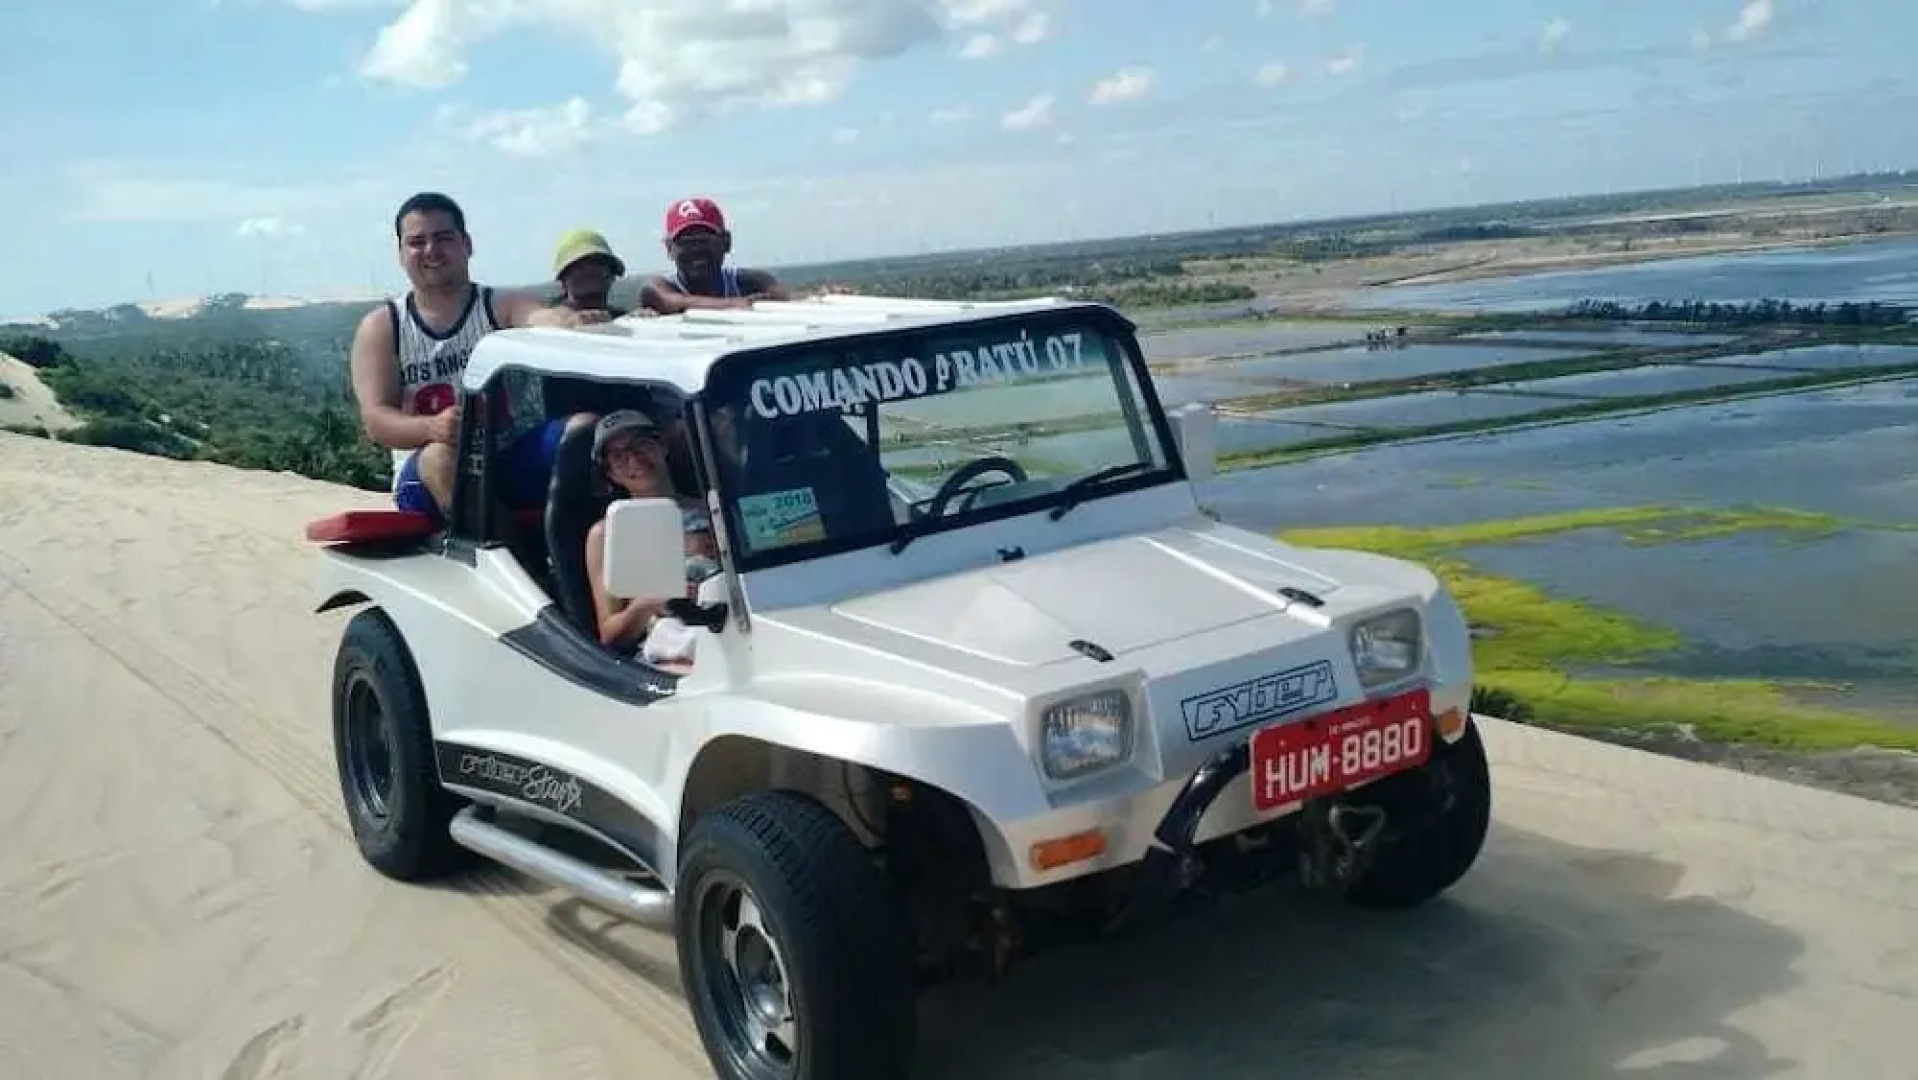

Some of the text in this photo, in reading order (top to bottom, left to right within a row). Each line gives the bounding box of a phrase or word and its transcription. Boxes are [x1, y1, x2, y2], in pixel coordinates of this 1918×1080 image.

[750, 357, 928, 420] COMANDO
[1045, 332, 1083, 371] 07
[1264, 716, 1423, 799] HUM-8880
